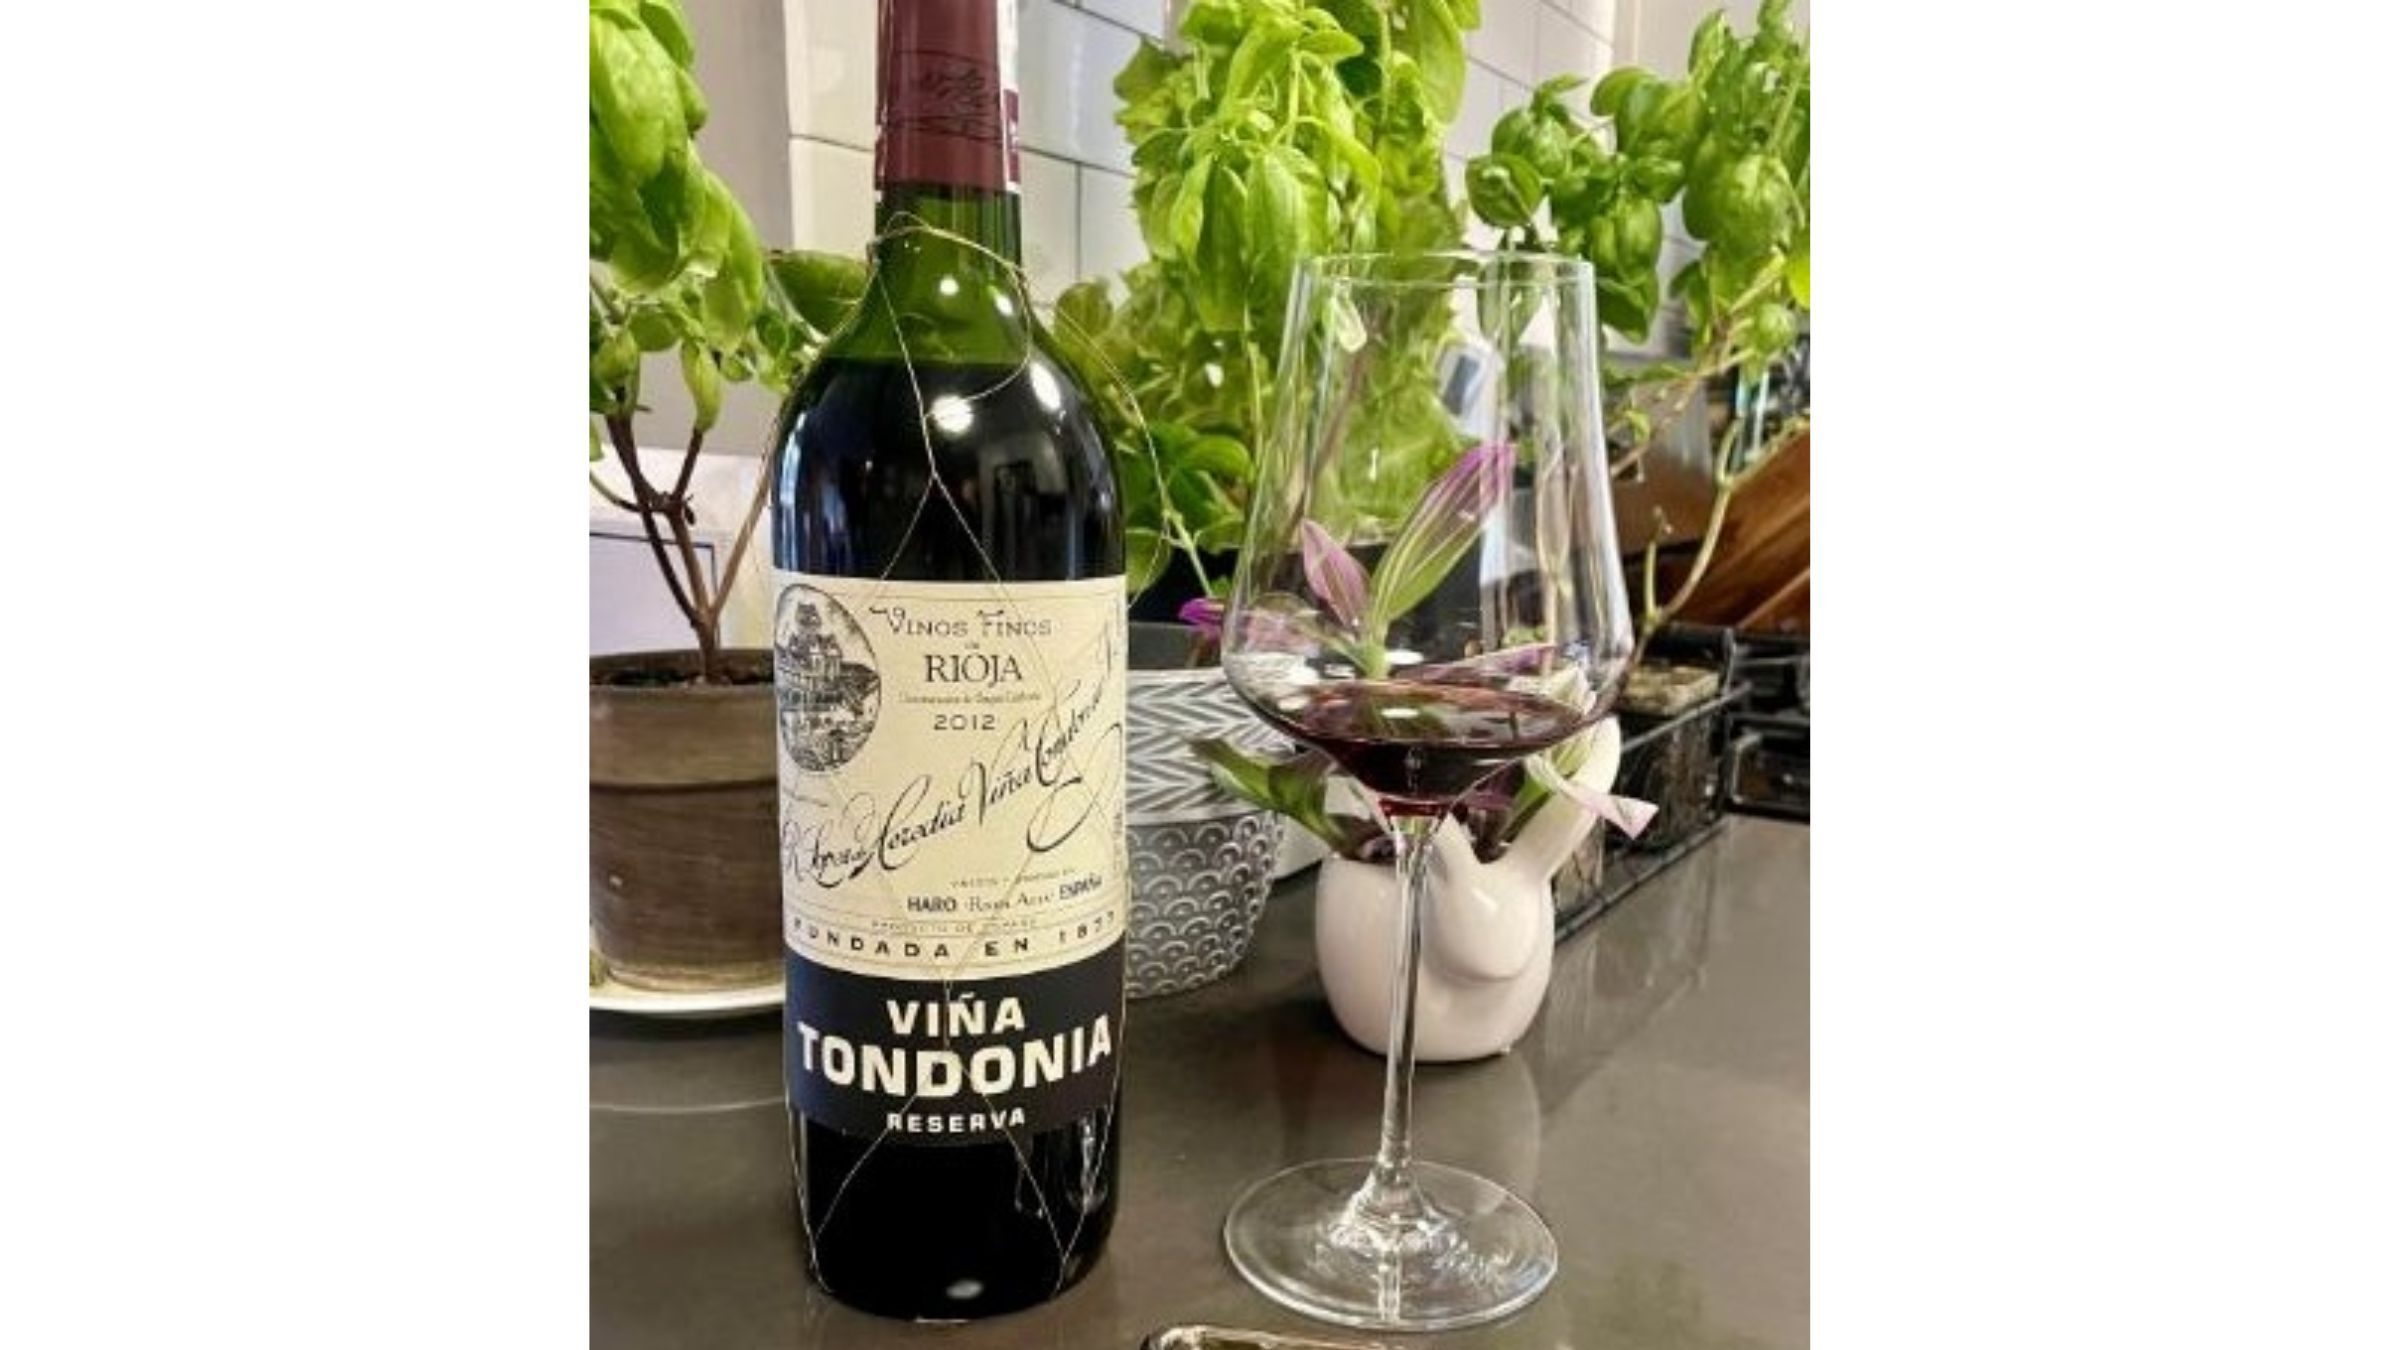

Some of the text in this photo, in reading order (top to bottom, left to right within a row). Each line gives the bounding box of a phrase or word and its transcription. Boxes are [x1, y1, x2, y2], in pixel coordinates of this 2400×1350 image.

[869, 606, 968, 637] VINOS
[924, 654, 1022, 688] RIOJA
[933, 714, 996, 731] 2012
[907, 896, 957, 912] HARO
[794, 917, 949, 958] FUNDADA
[984, 937, 1029, 957] EN
[886, 991, 1026, 1038] VIÑA
[797, 1013, 1113, 1098] TONDONIA
[887, 1106, 1026, 1134] RESERVA
